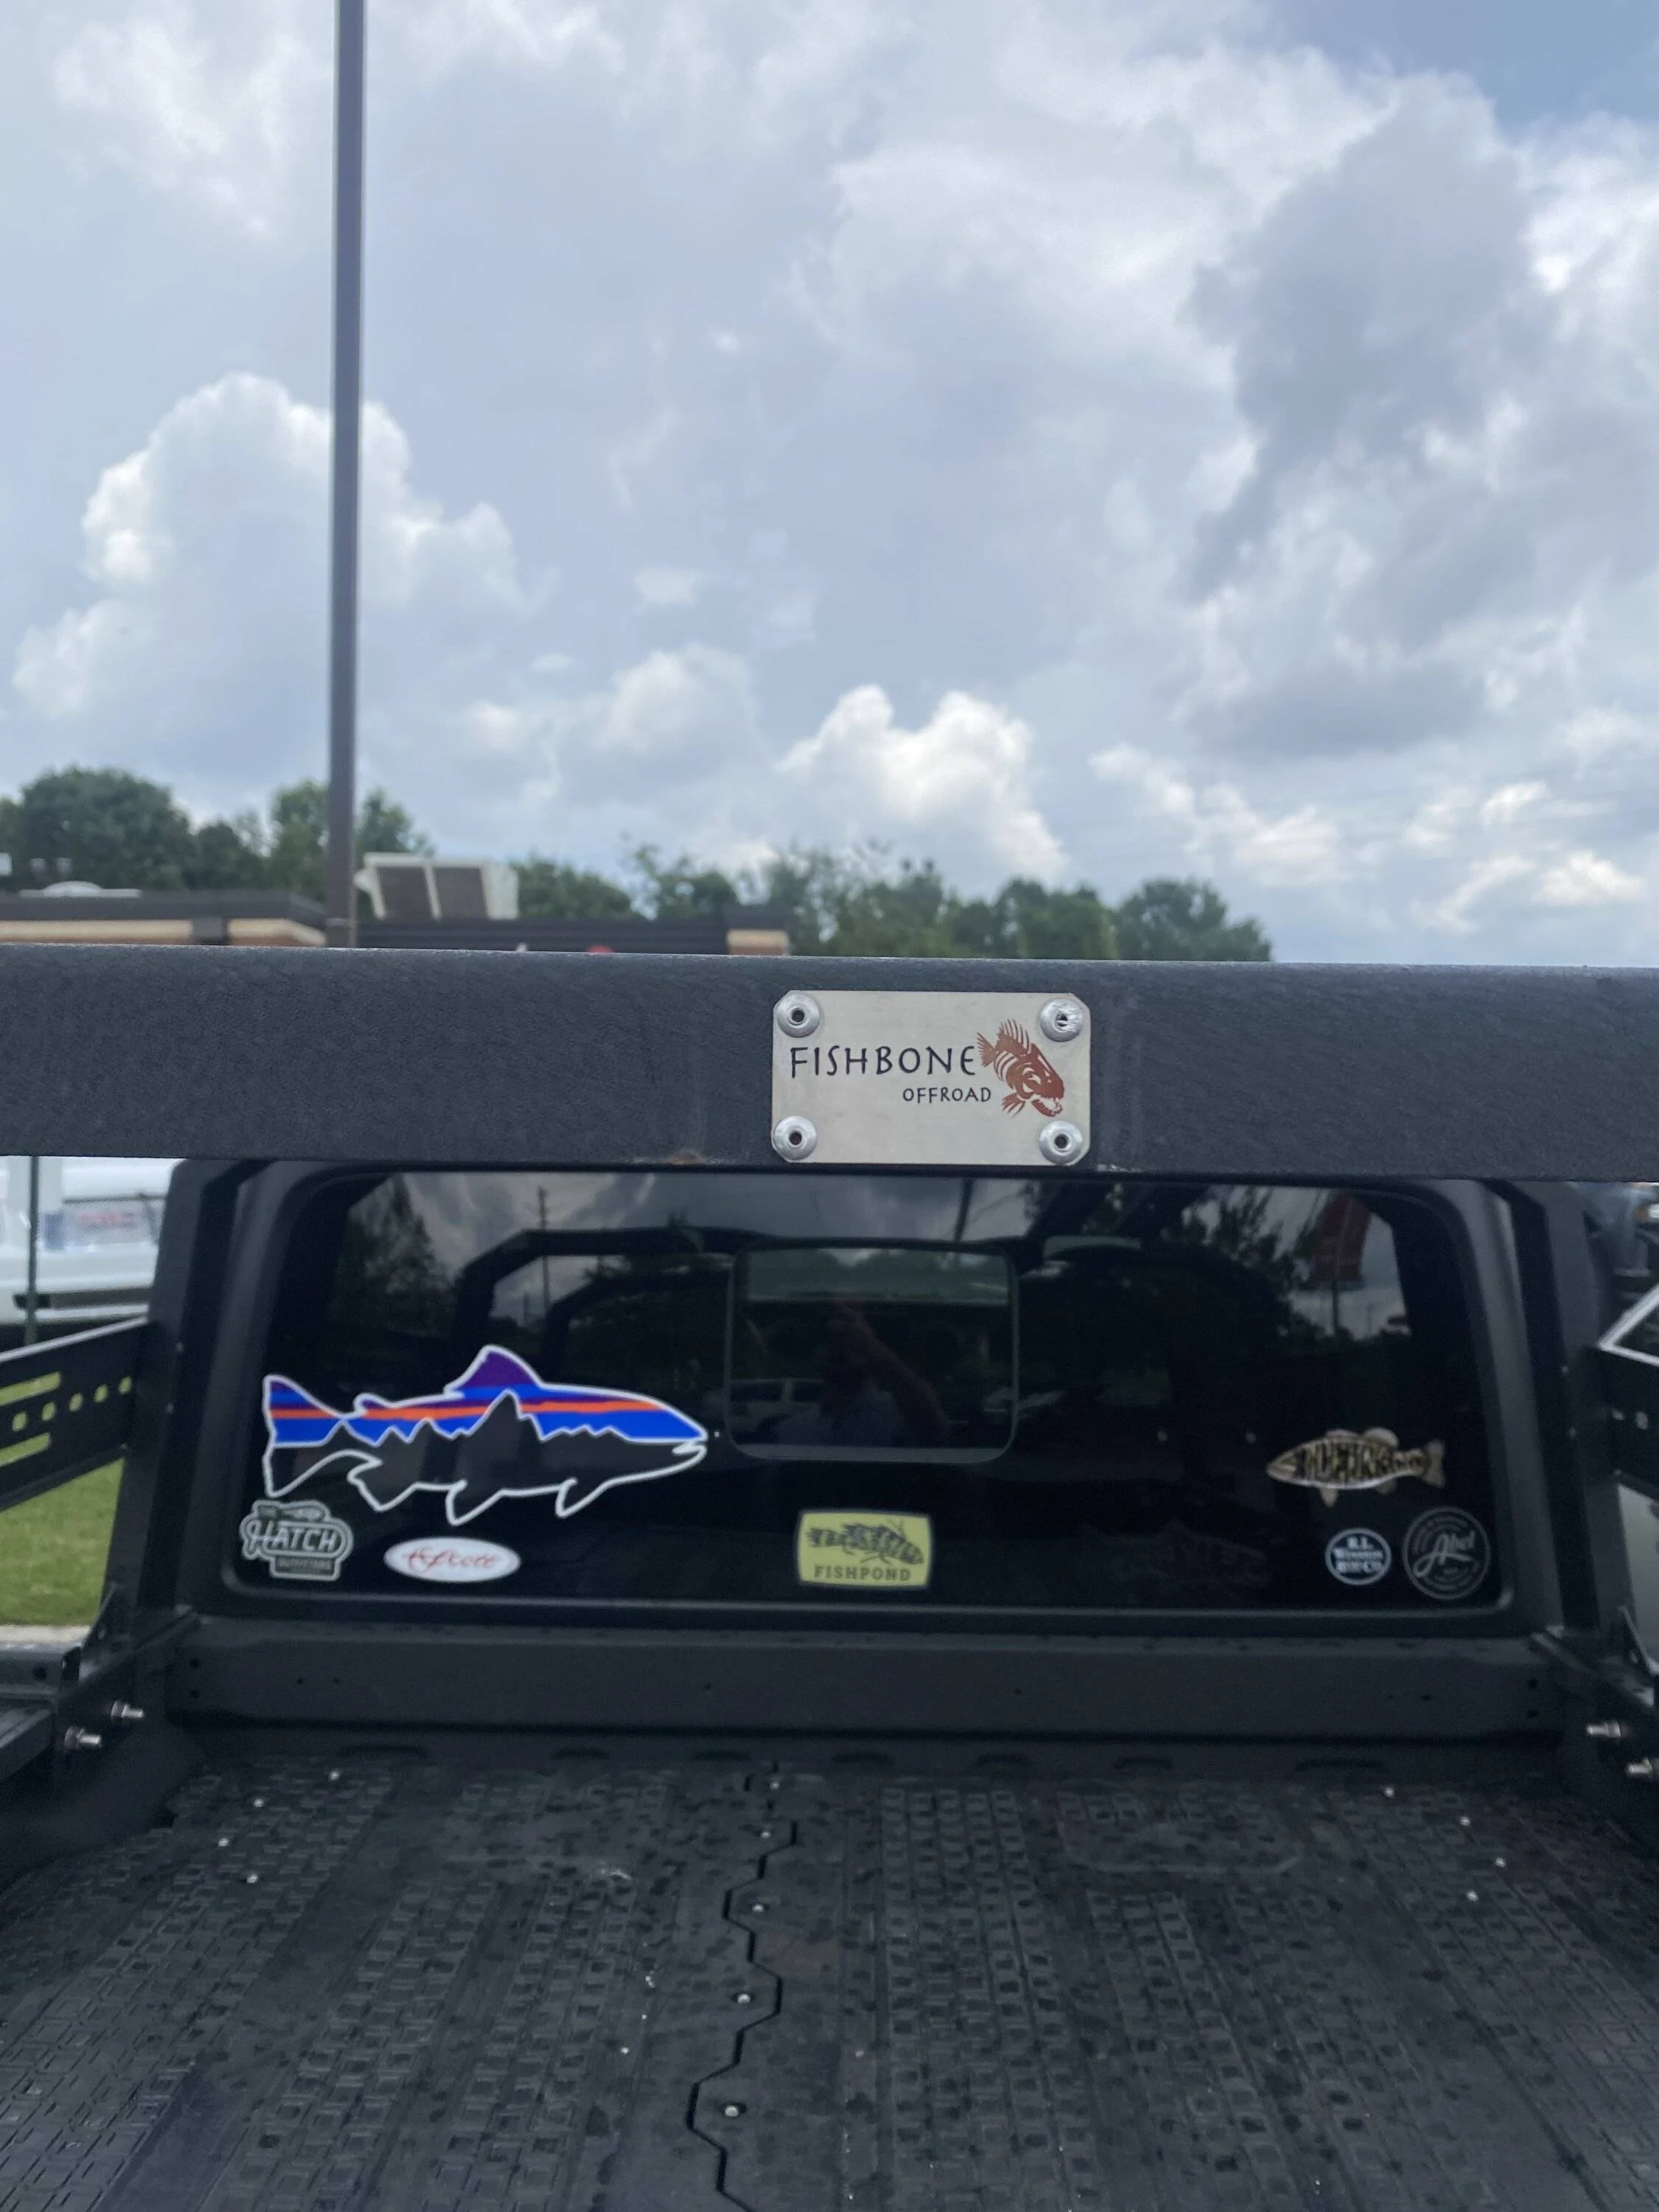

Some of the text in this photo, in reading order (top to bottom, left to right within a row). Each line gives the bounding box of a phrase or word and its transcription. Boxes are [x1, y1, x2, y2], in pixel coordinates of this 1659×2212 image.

[790, 1045, 975, 1078] FISHBONE
[902, 1087, 992, 1103] OFFROAD
[813, 1565, 912, 1582] FISHPOND
